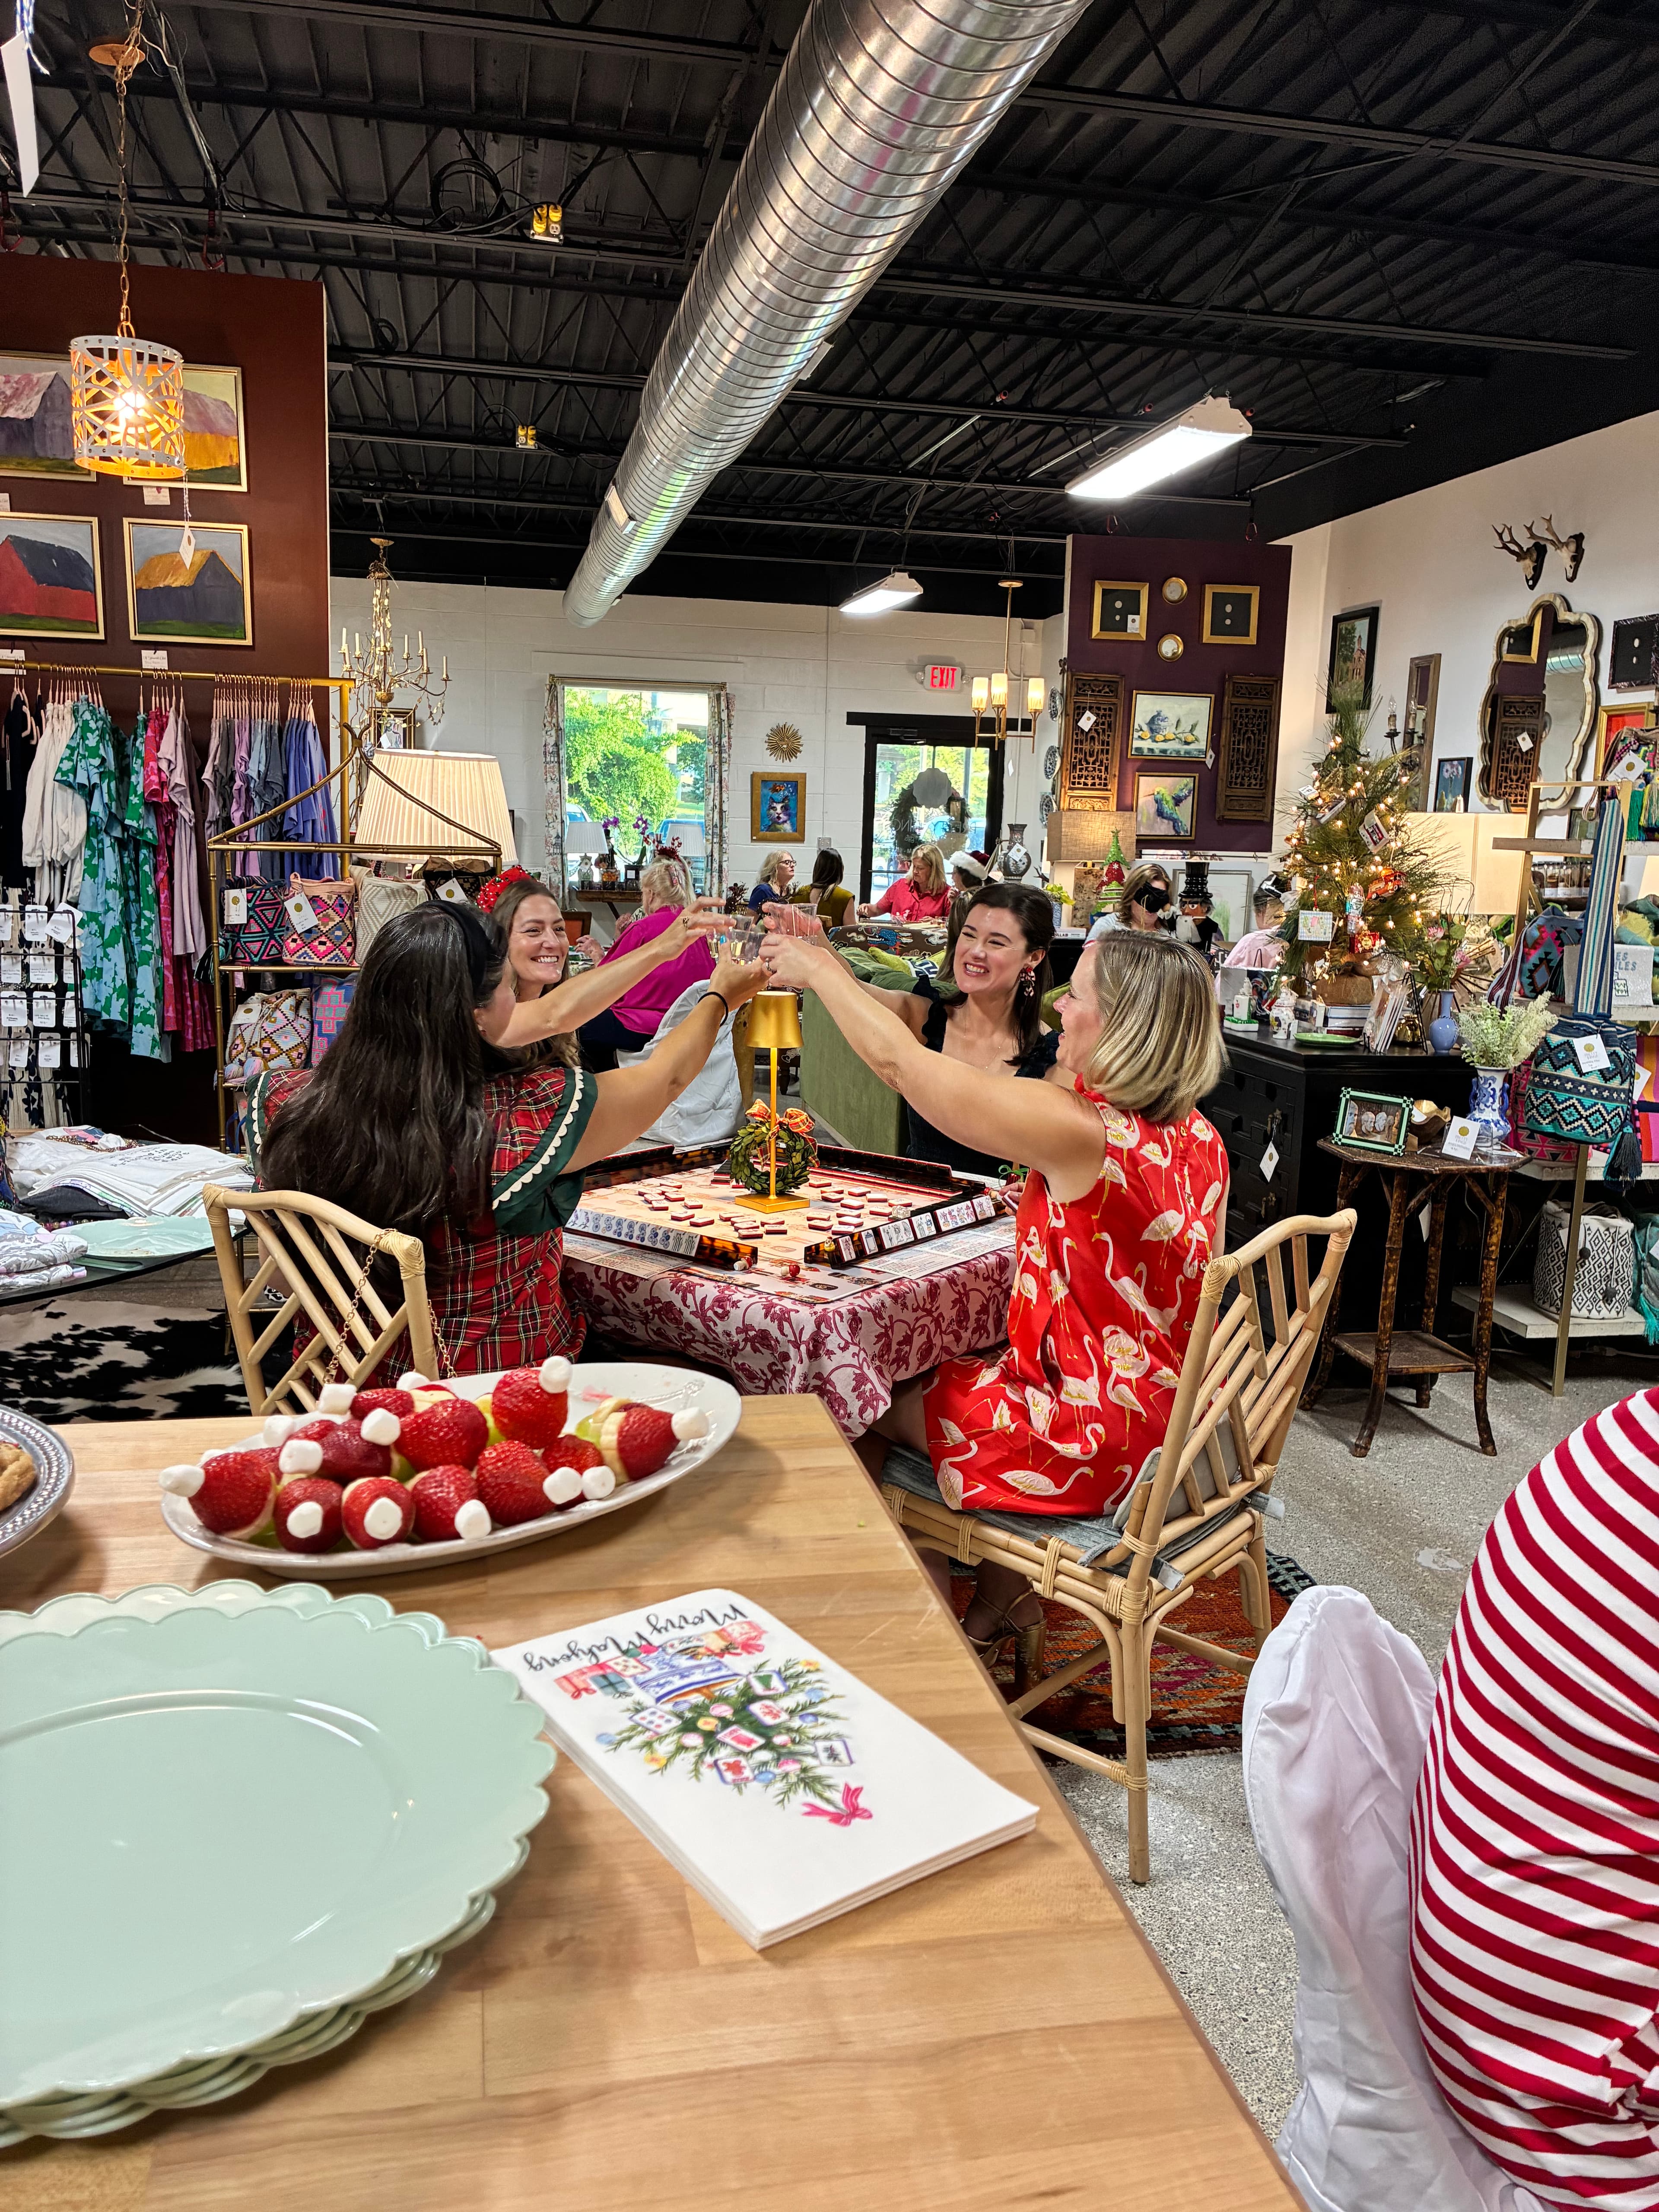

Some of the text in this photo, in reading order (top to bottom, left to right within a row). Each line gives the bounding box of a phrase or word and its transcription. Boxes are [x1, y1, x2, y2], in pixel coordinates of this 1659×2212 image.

[931, 667, 957, 689] EXIT
[1616, 952, 1628, 961] ES
[1615, 961, 1637, 971] ILES
[523, 1604, 748, 1672] Merry Mahjong
